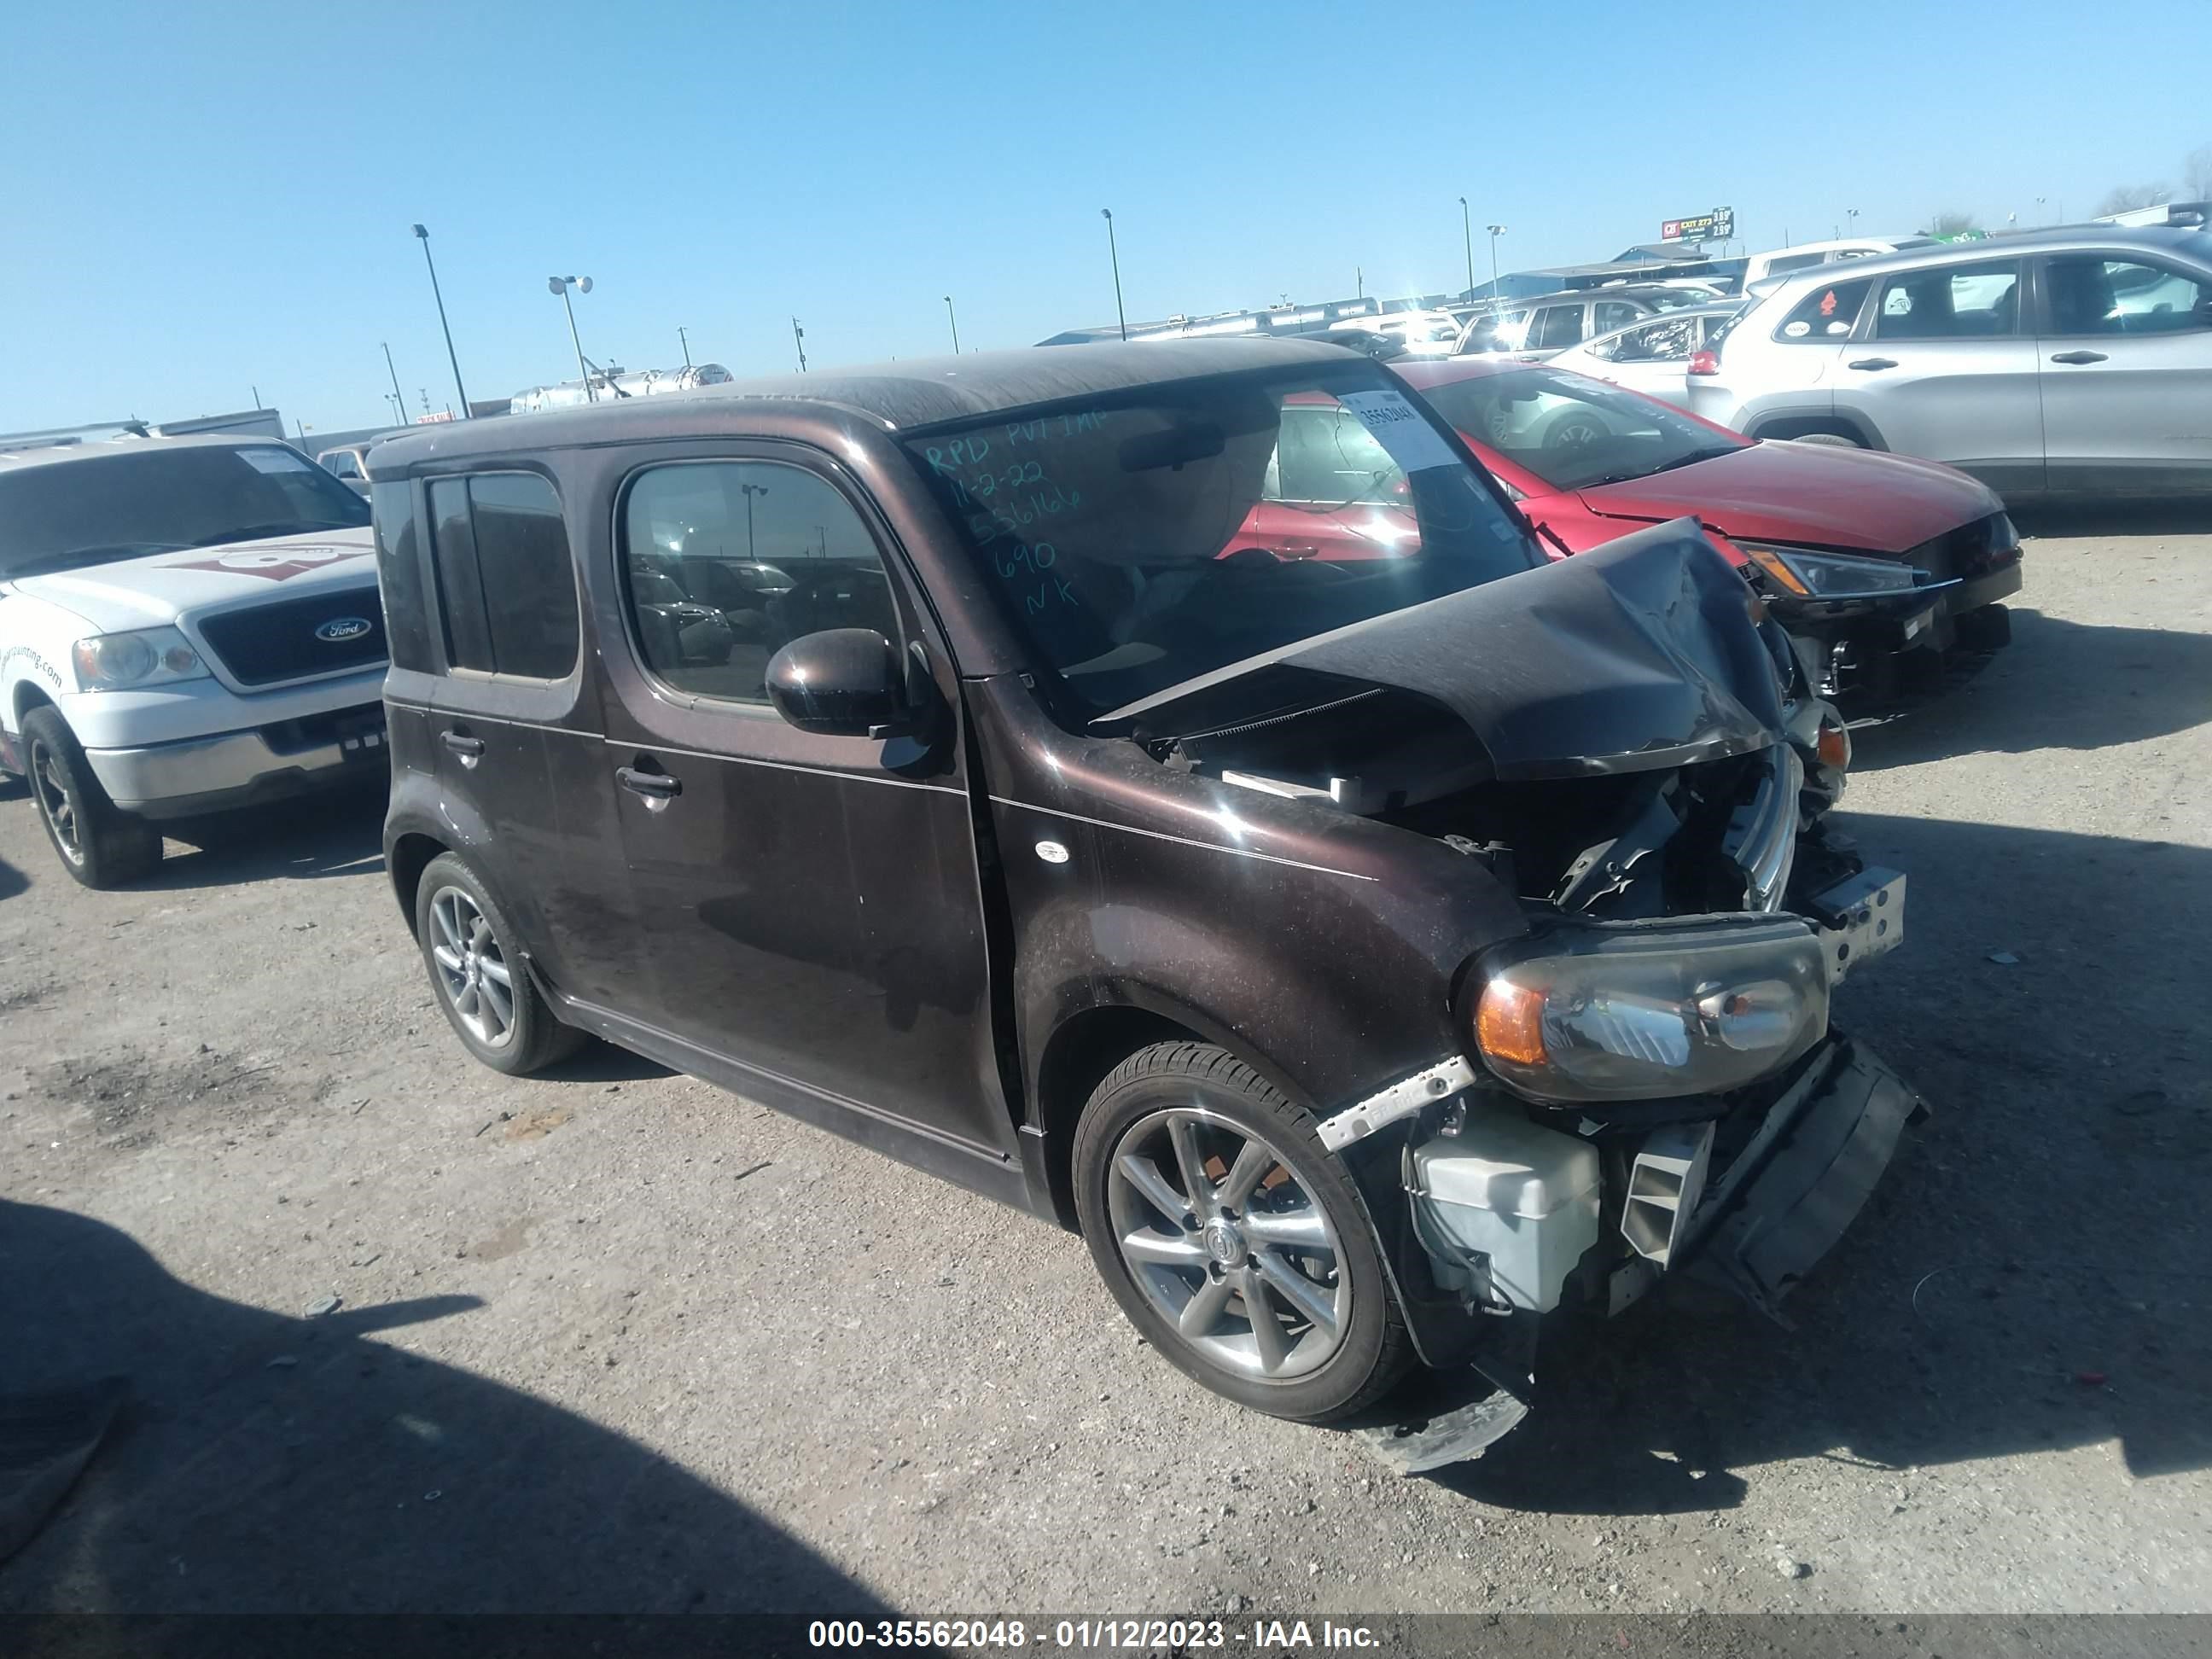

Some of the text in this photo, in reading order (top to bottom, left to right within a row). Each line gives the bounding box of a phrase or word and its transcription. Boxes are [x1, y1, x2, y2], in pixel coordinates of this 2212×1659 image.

[1680, 218, 1712, 229] EXIT 273
[1360, 405, 1417, 426] 35562048
[925, 437, 990, 476] RPD
[995, 542, 1056, 579] 690
[329, 623, 359, 637] Ford
